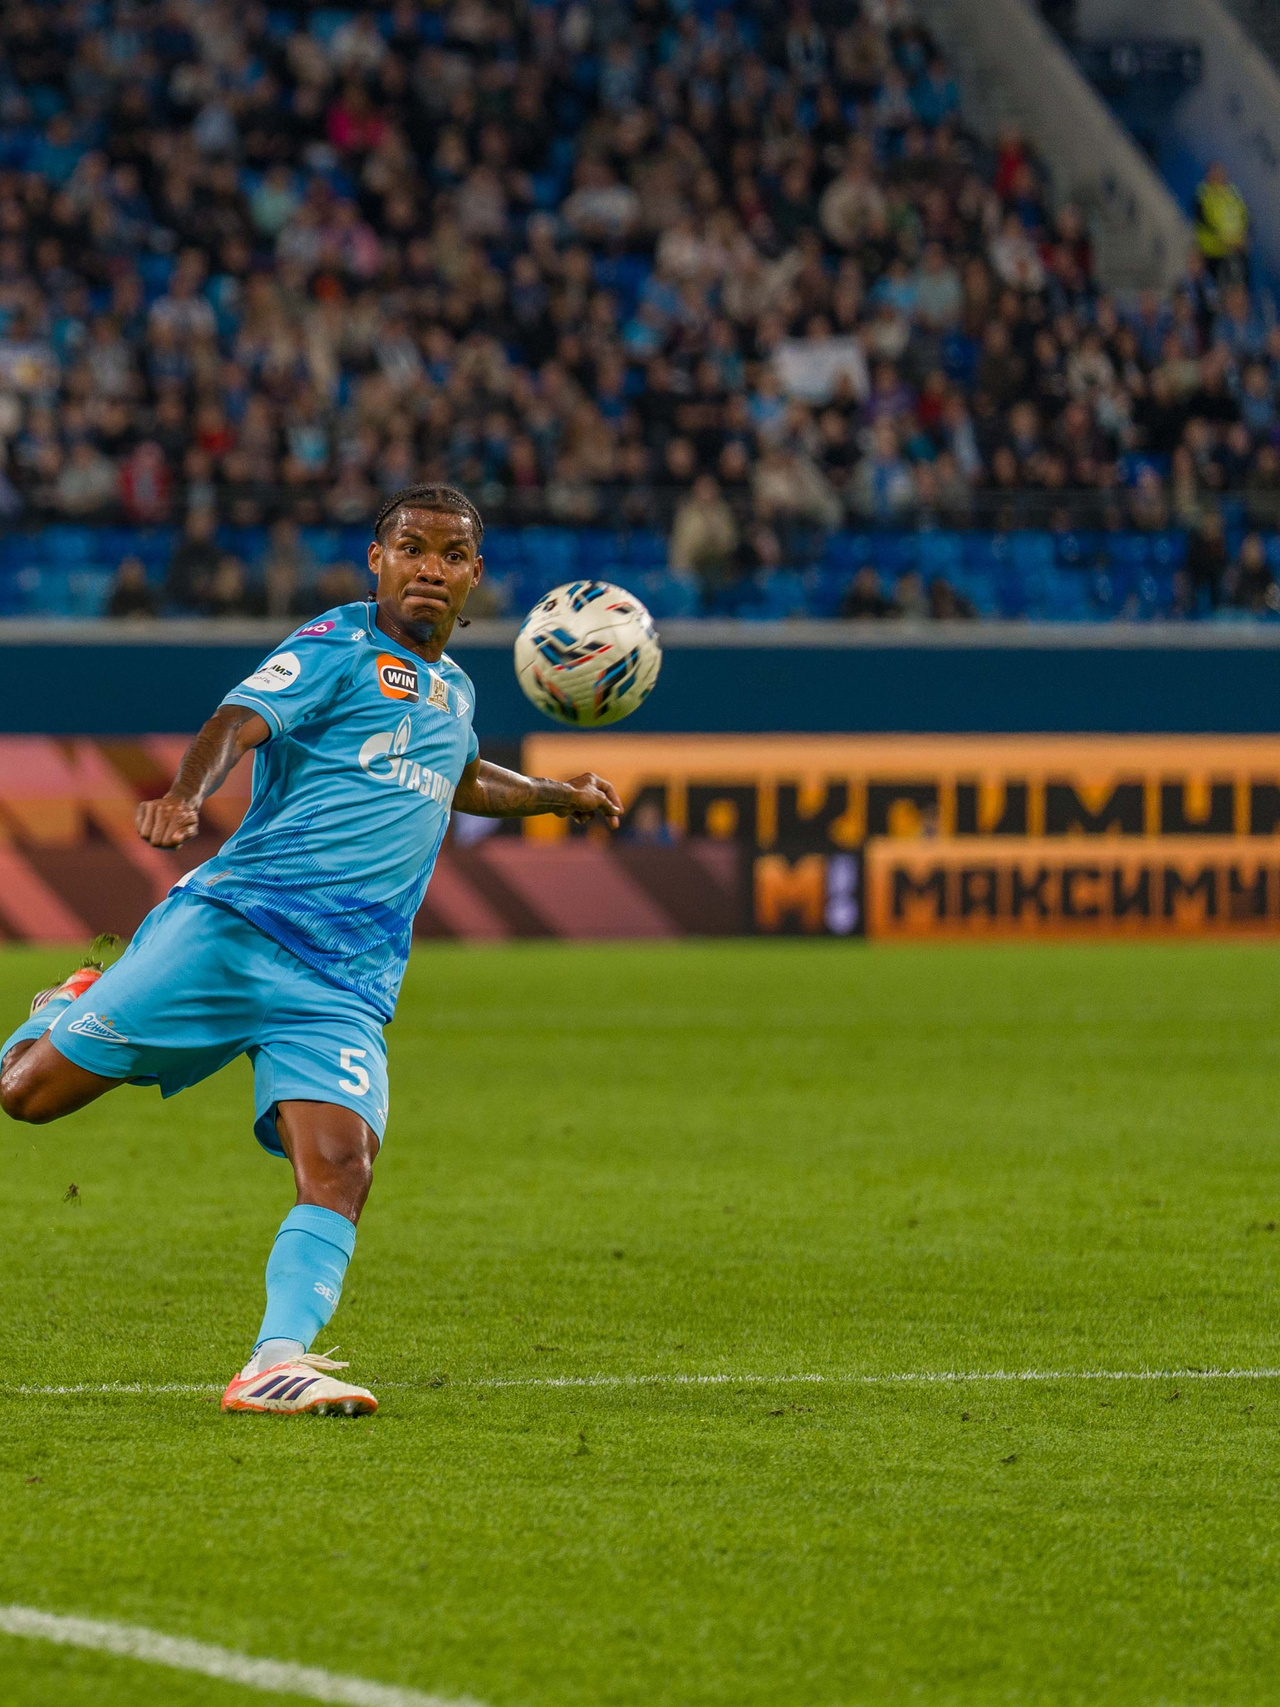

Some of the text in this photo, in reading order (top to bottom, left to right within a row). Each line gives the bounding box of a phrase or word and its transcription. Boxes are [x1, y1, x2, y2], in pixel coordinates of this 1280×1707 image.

[387, 670, 415, 689] WIN
[398, 758, 455, 820] ГАЗПРО
[892, 866, 1280, 918] МАКСИМУ
[339, 1048, 370, 1096] 5
